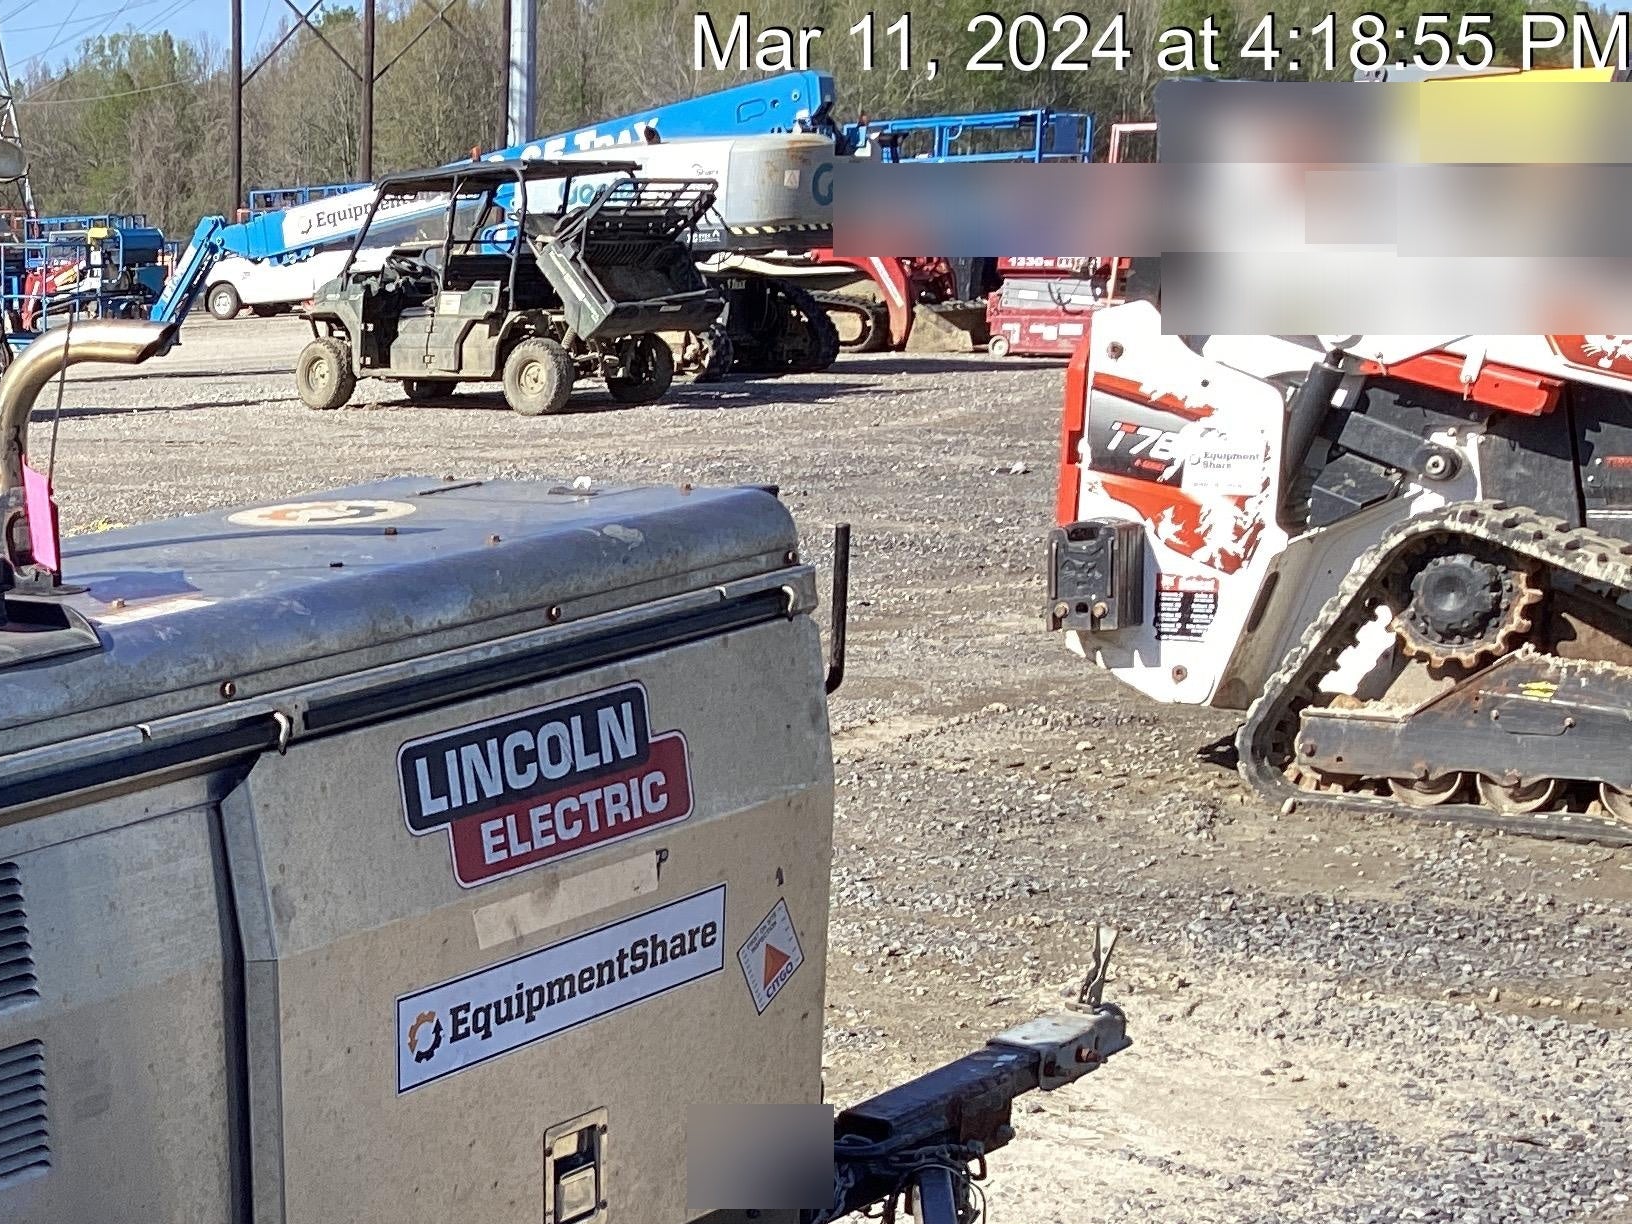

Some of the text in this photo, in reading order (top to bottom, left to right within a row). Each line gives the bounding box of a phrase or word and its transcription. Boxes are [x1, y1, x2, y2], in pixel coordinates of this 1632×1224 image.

[415, 701, 638, 817] LINCOLN
[480, 770, 668, 866] ELECTRIC
[449, 920, 718, 1041] EquipmentShare
[766, 961, 794, 998] CITGO
